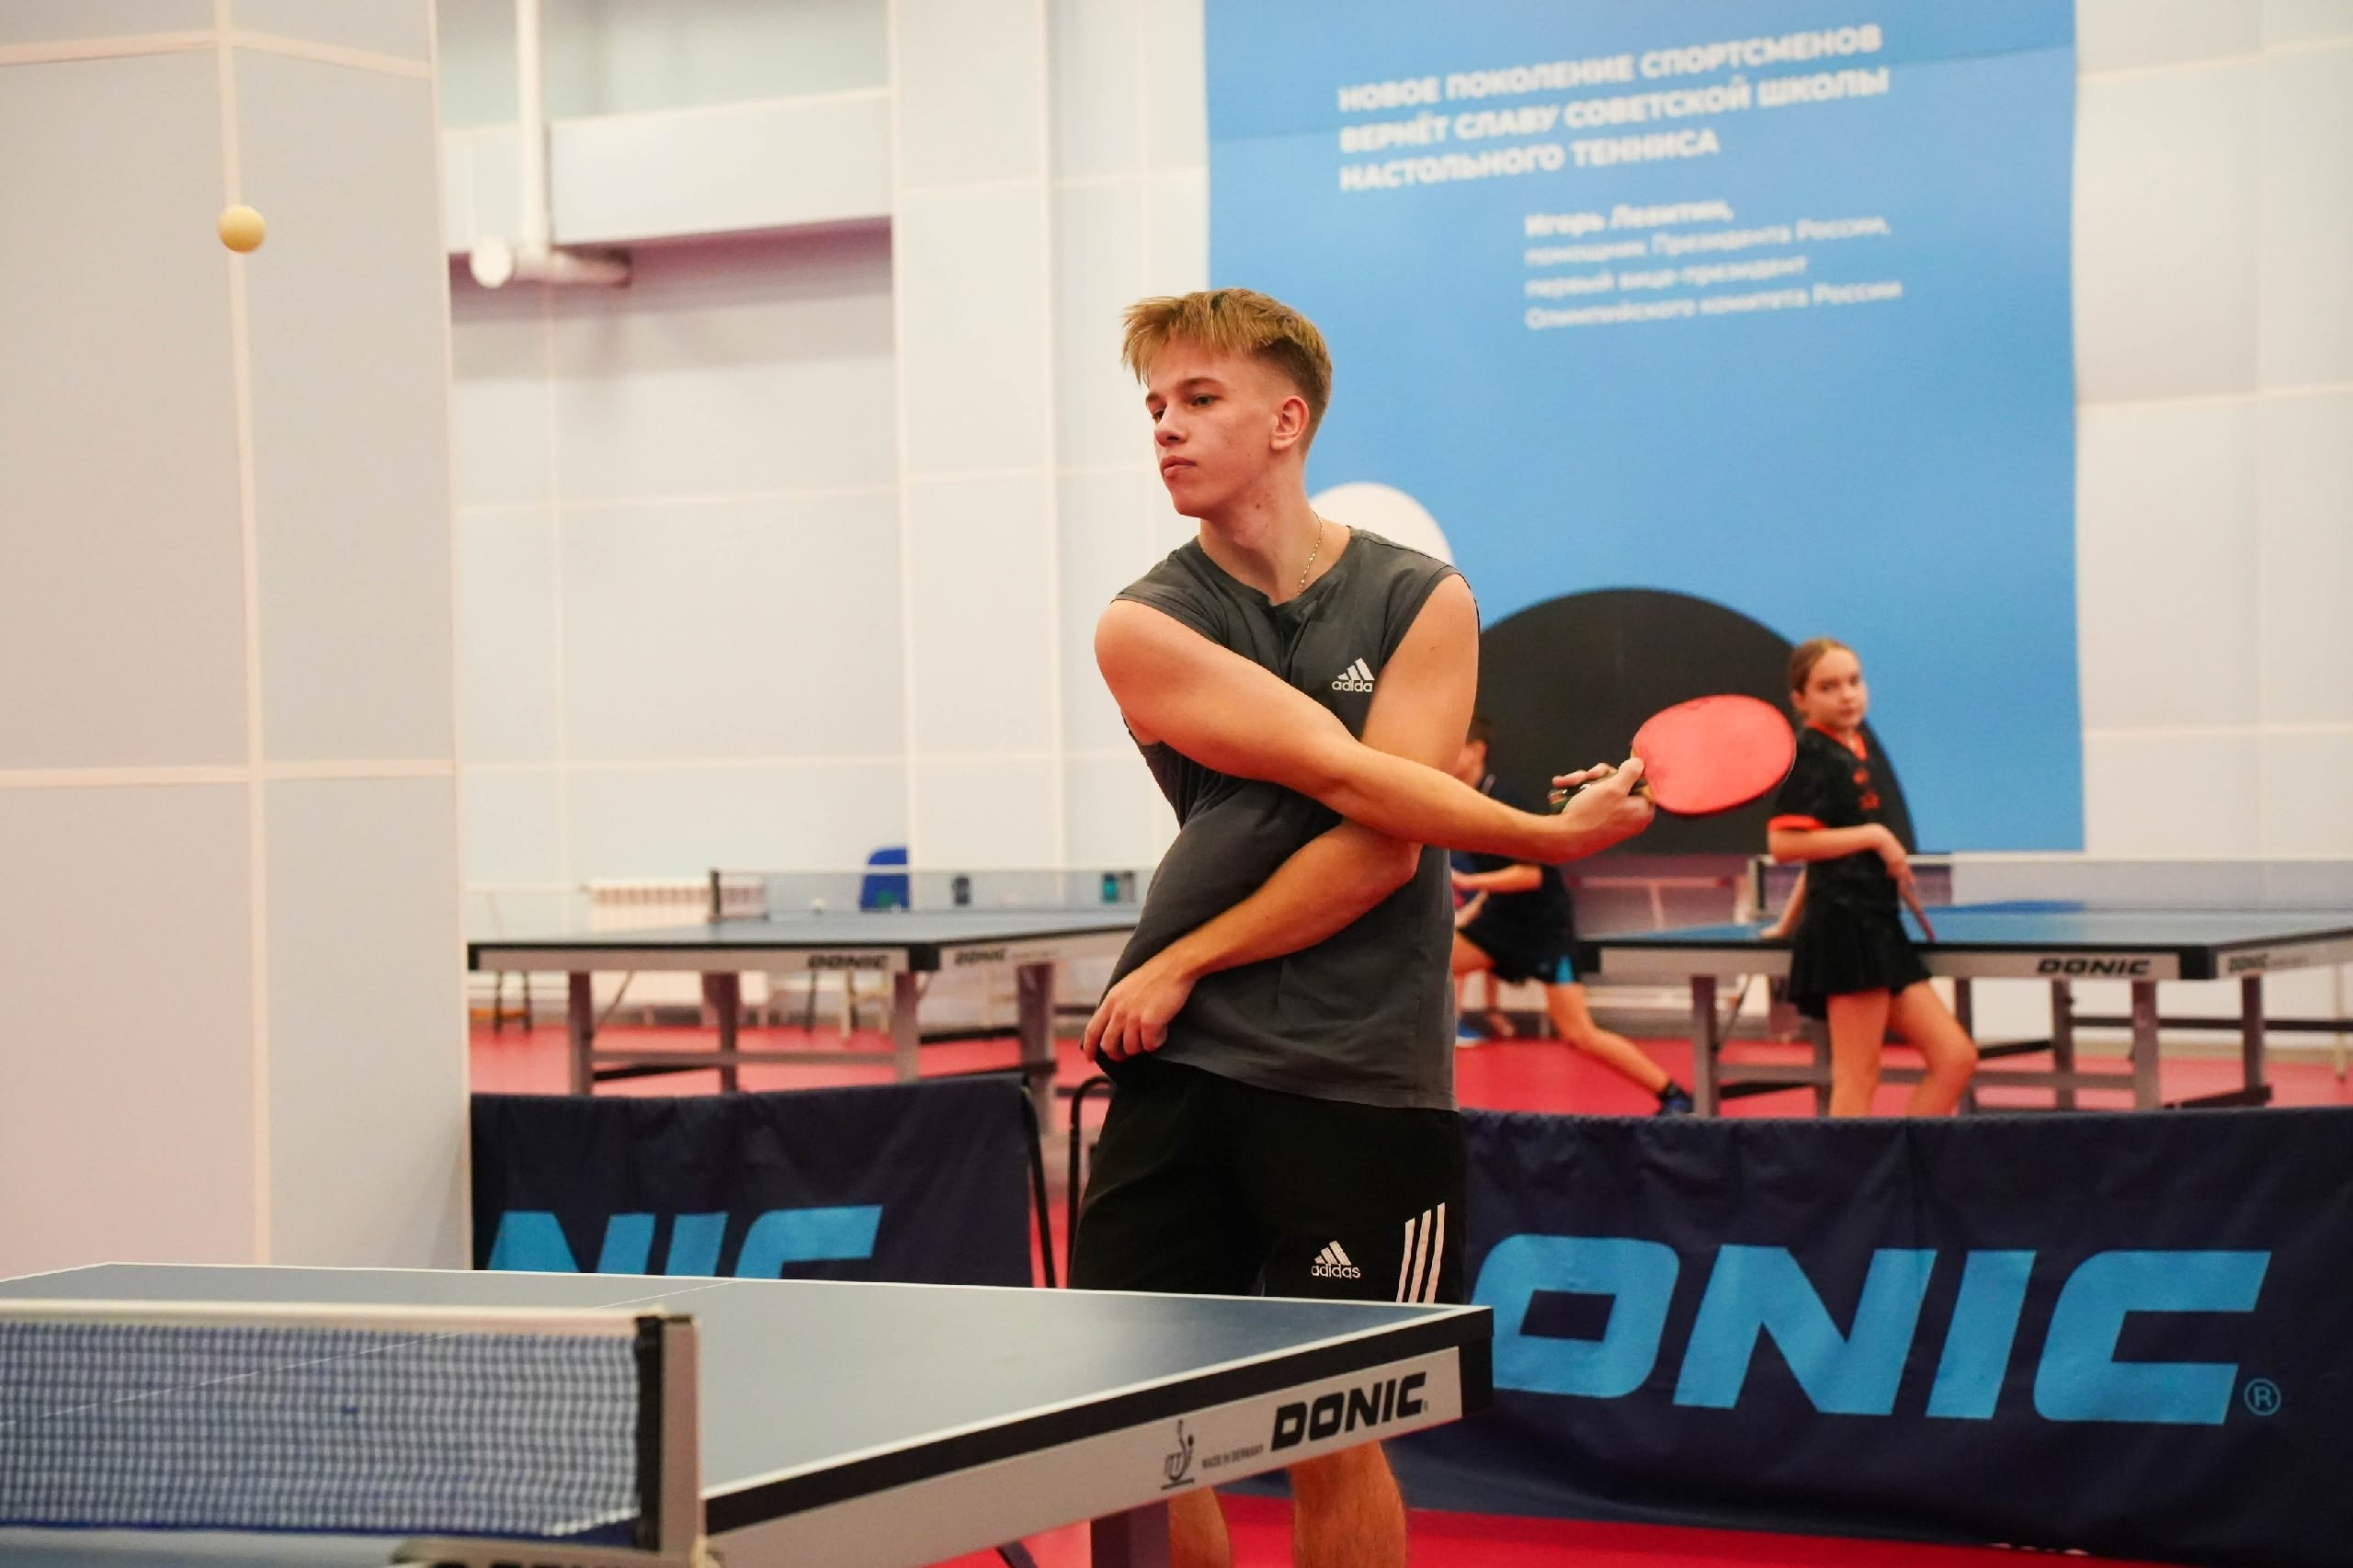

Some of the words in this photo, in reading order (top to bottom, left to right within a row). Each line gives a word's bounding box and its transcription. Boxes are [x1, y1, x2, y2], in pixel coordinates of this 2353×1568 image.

[1339, 76, 1440, 112] НОВОЕ
[1446, 53, 1634, 100] ПОКОЛЕНИЕ
[1640, 24, 1882, 78] СПОРТСМЕНОВ
[1454, 103, 1560, 140] СЛАВУ
[1564, 74, 1751, 130] СОВЕТСКОЙ
[1757, 66, 1890, 108] ШКОЛЫ
[1339, 142, 1564, 191] НАСТОЛЬНОГО
[1571, 128, 1720, 167] ТЕННИСА
[1331, 680, 1374, 693] adida
[2036, 957, 2153, 976] DONIC
[1311, 1263, 1361, 1279] adidas
[1471, 1233, 2271, 1425] ONIC
[1271, 1371, 1427, 1452] DONIC
